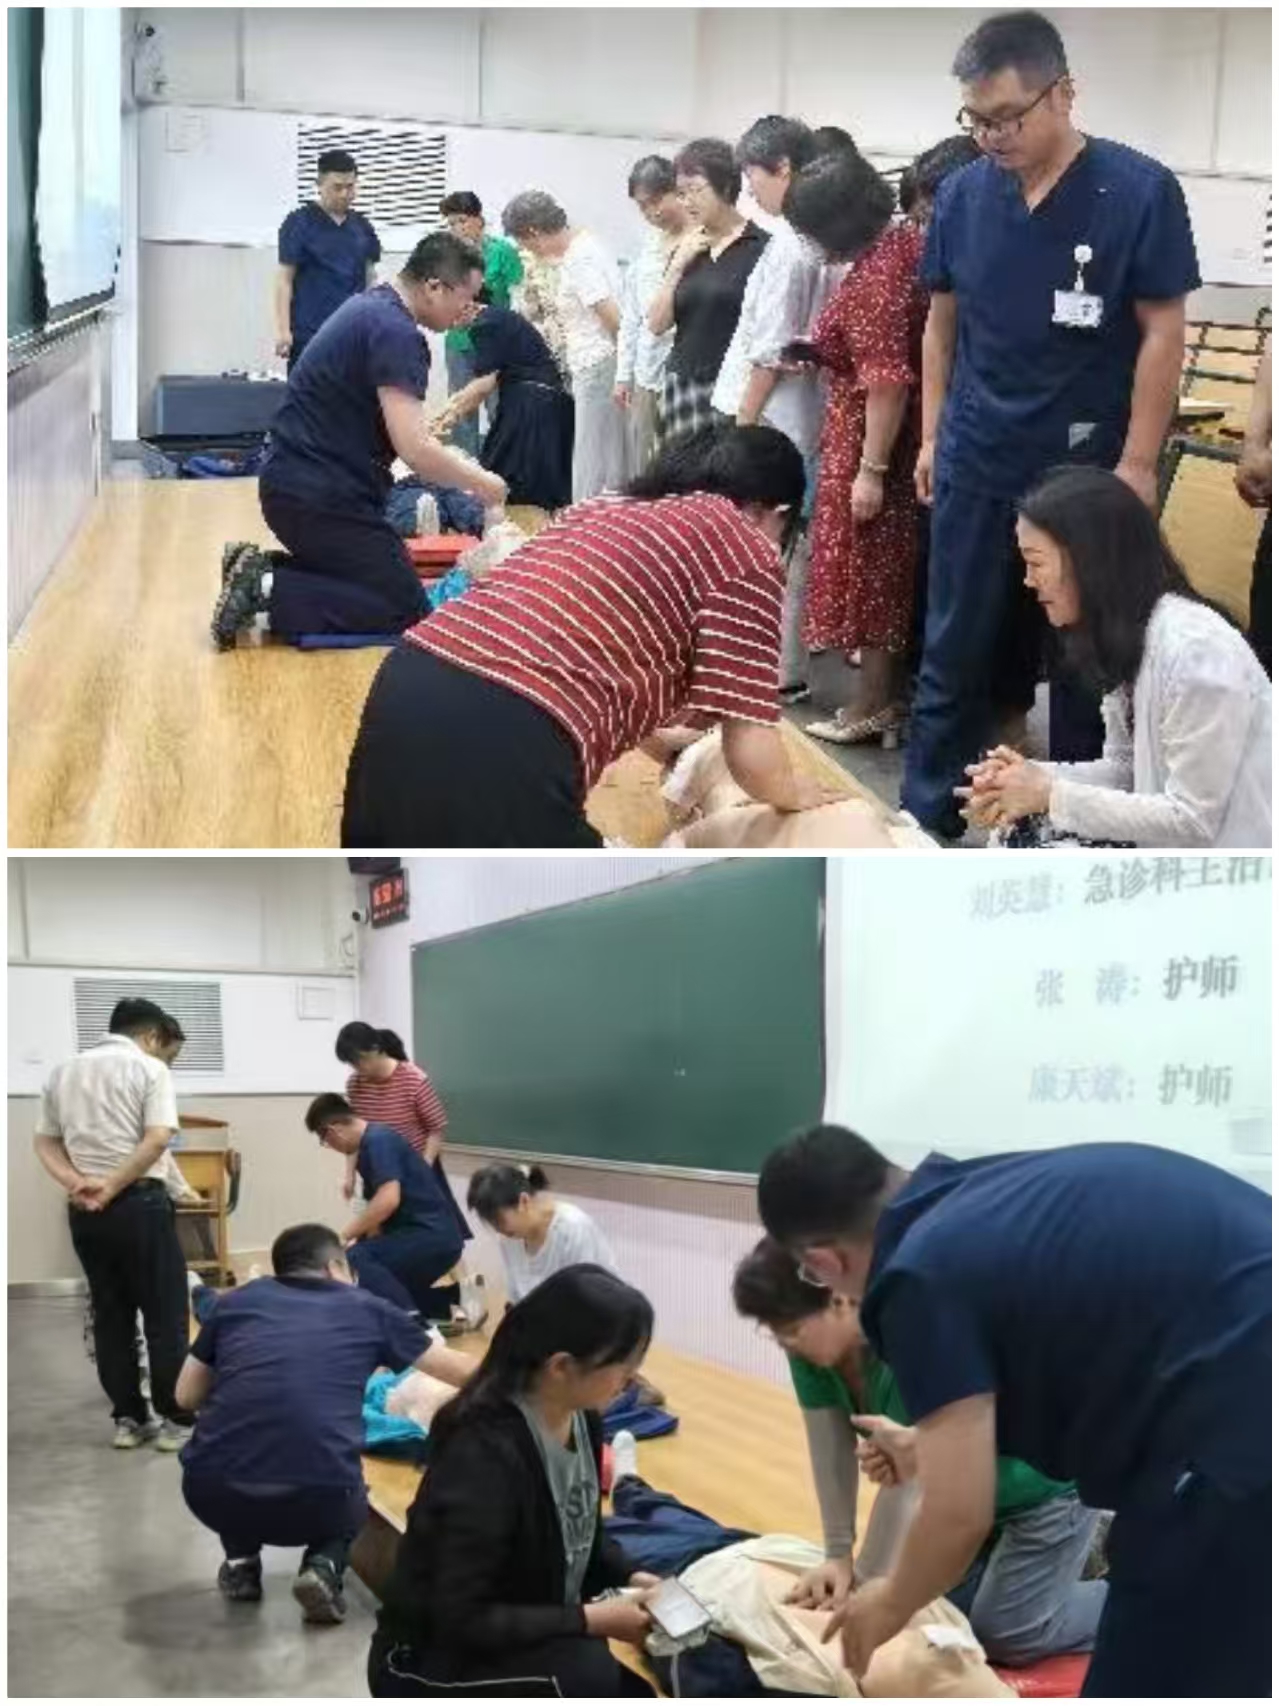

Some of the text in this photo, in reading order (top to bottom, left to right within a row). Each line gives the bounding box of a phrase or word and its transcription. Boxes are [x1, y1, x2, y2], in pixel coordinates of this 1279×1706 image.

[1084, 857, 1272, 904] 急诊科主治
[1036, 968, 1064, 1007] 张
[1163, 955, 1239, 1001] 护师
[1158, 1063, 1234, 1107] 护师
